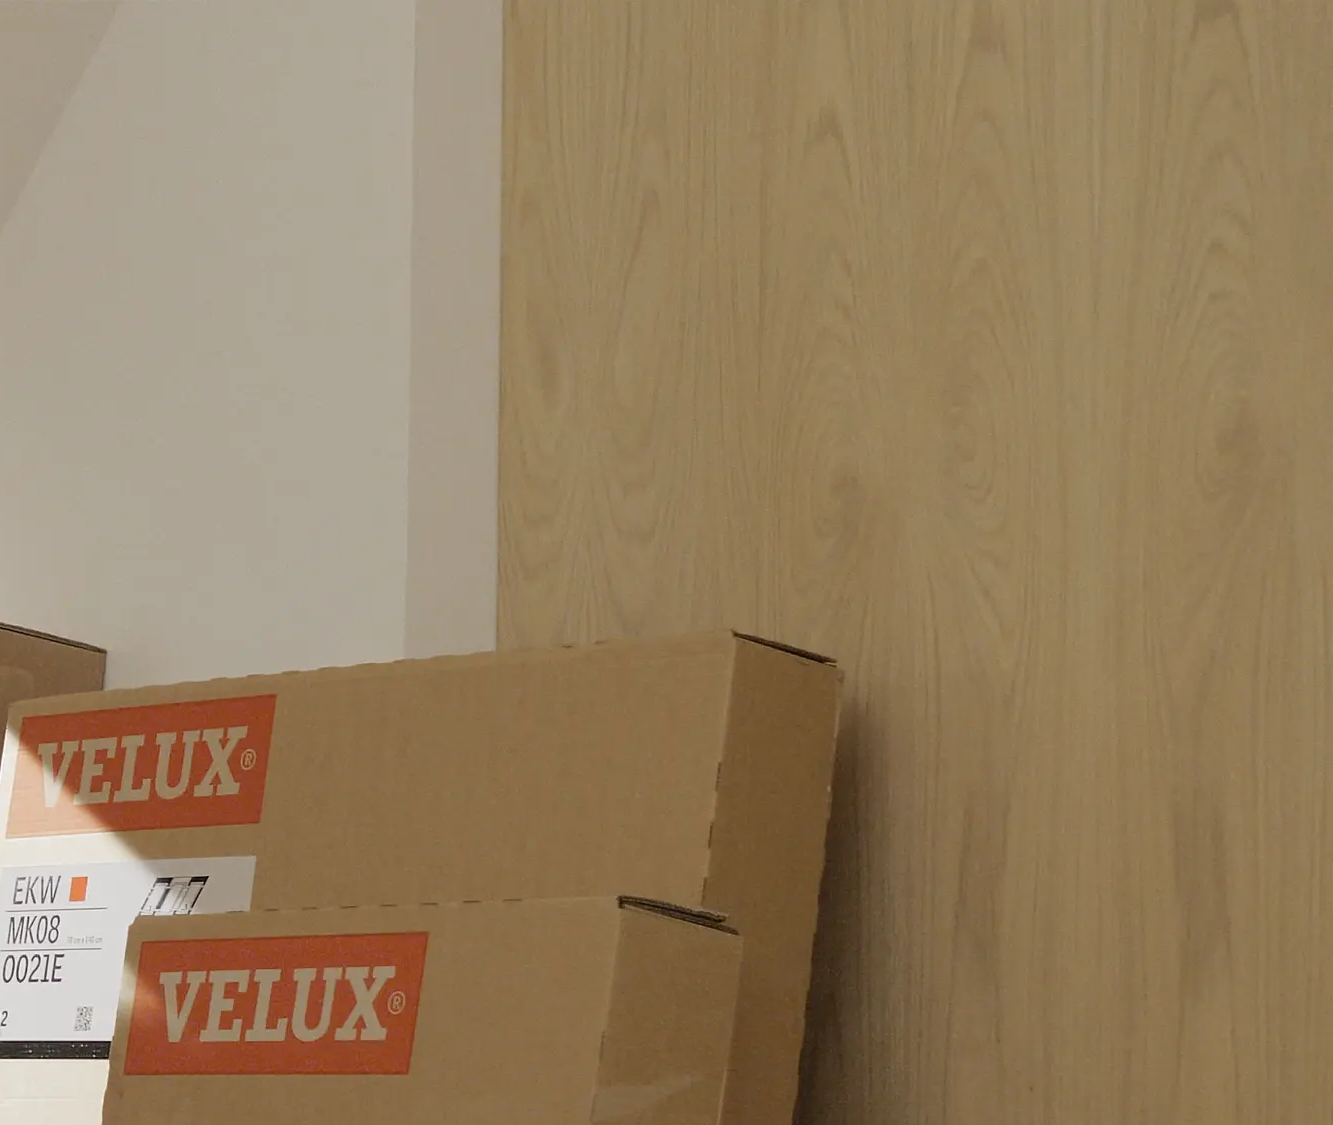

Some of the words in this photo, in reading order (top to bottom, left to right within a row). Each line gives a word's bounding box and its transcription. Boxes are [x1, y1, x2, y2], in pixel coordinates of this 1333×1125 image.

[13, 875, 61, 904] EKW
[7, 915, 60, 944] MK08
[2, 954, 65, 983] 0021E
